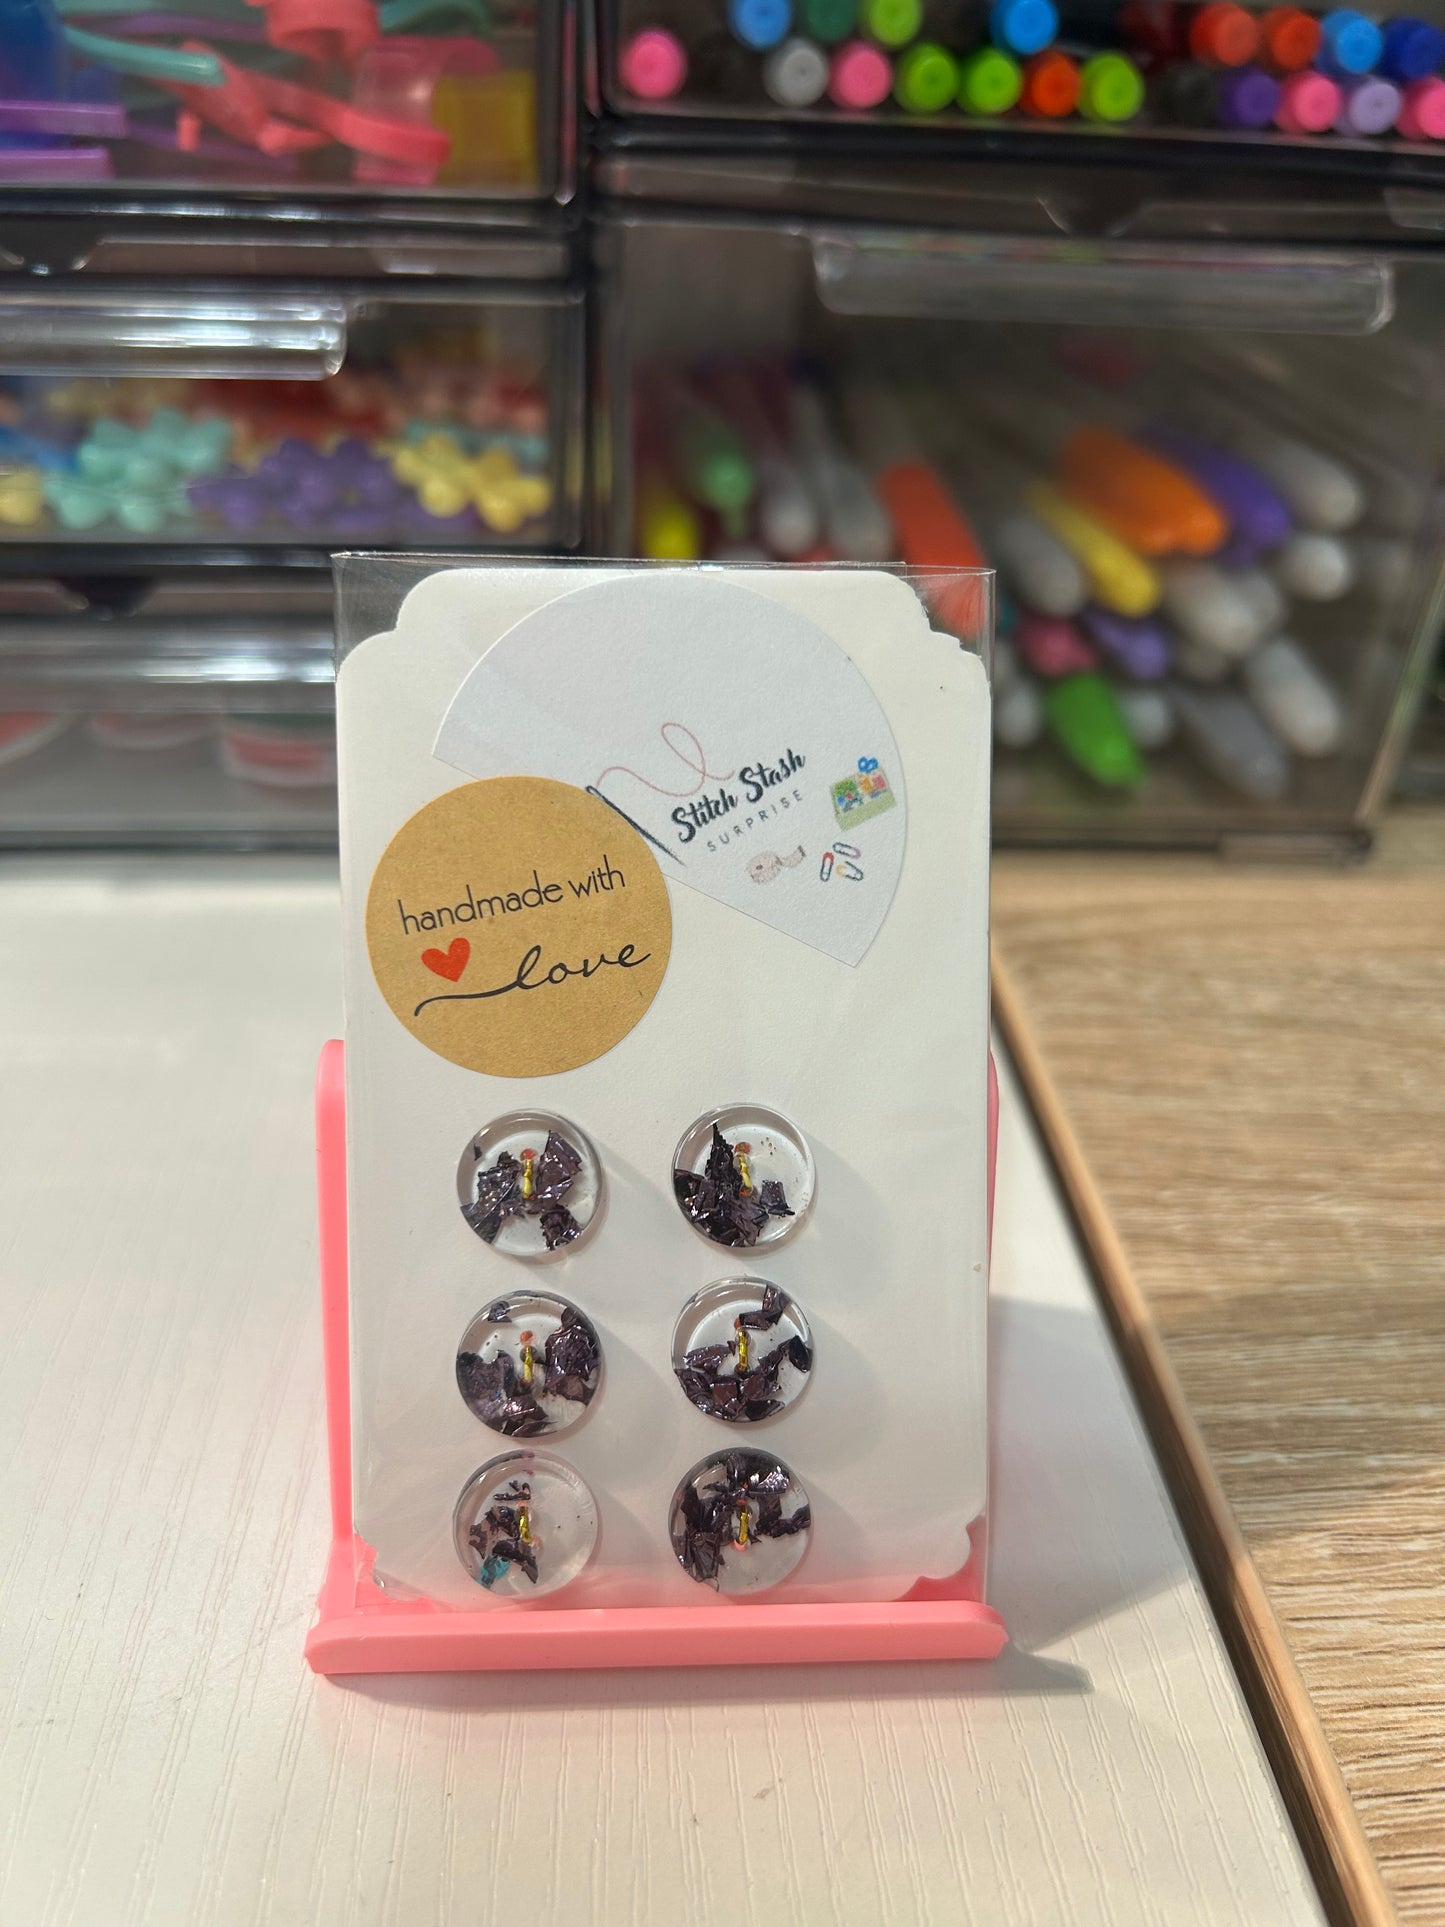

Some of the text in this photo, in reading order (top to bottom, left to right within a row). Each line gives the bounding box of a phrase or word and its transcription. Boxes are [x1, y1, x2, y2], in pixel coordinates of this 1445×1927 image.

[671, 748, 806, 844] Stitch Stash
[706, 789, 803, 852] SURPRISE
[397, 854, 626, 935] handmade with
